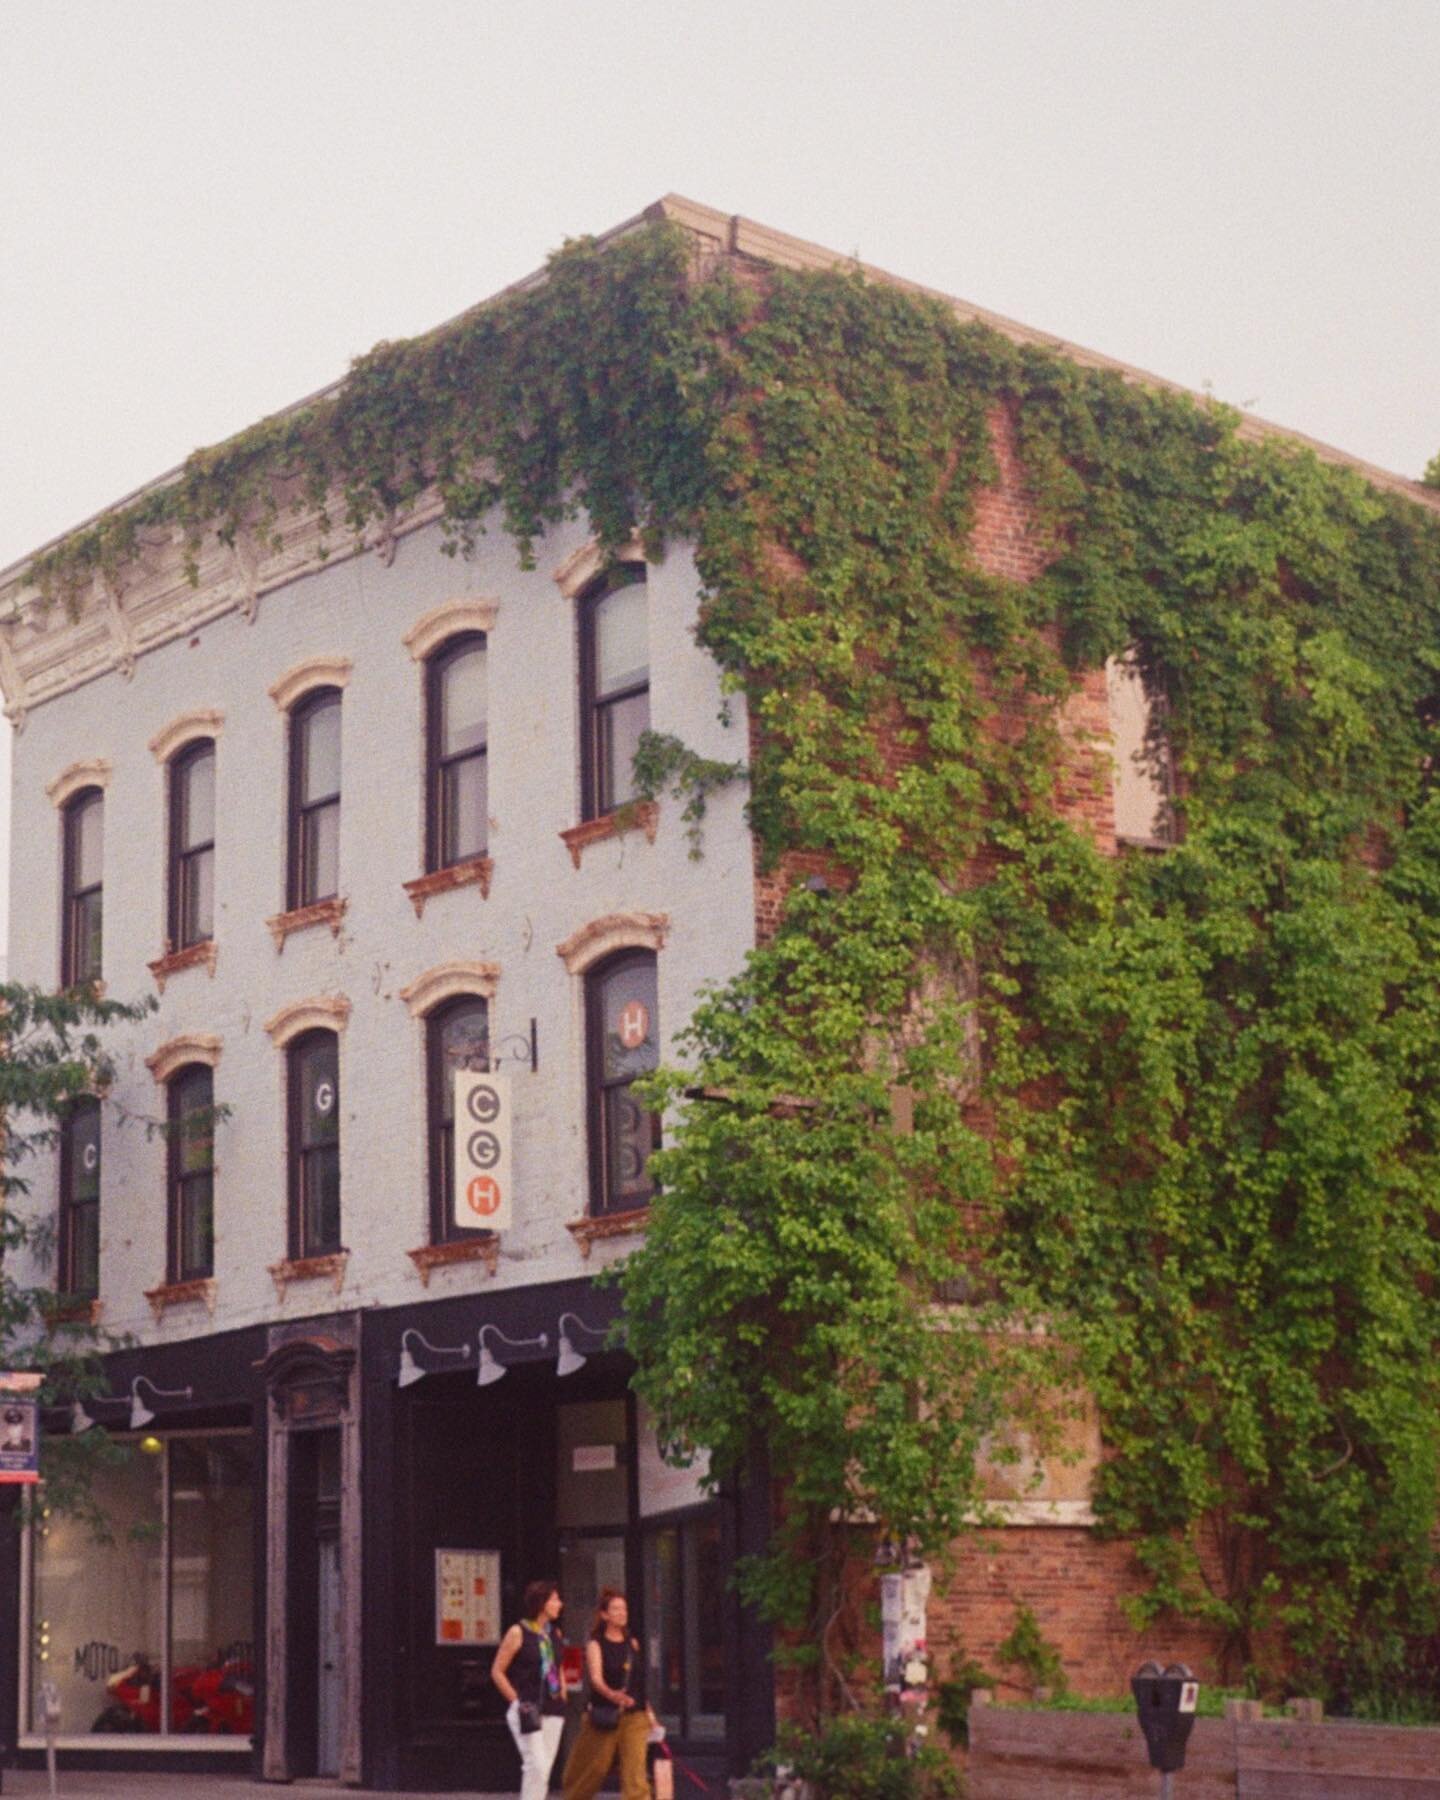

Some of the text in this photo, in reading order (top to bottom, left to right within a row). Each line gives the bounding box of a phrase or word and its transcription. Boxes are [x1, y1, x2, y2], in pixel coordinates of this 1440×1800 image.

[623, 1008, 642, 1040] H
[316, 1083, 332, 1110] G
[83, 1143, 96, 1169] C
[74, 1640, 120, 1681] MOTO
